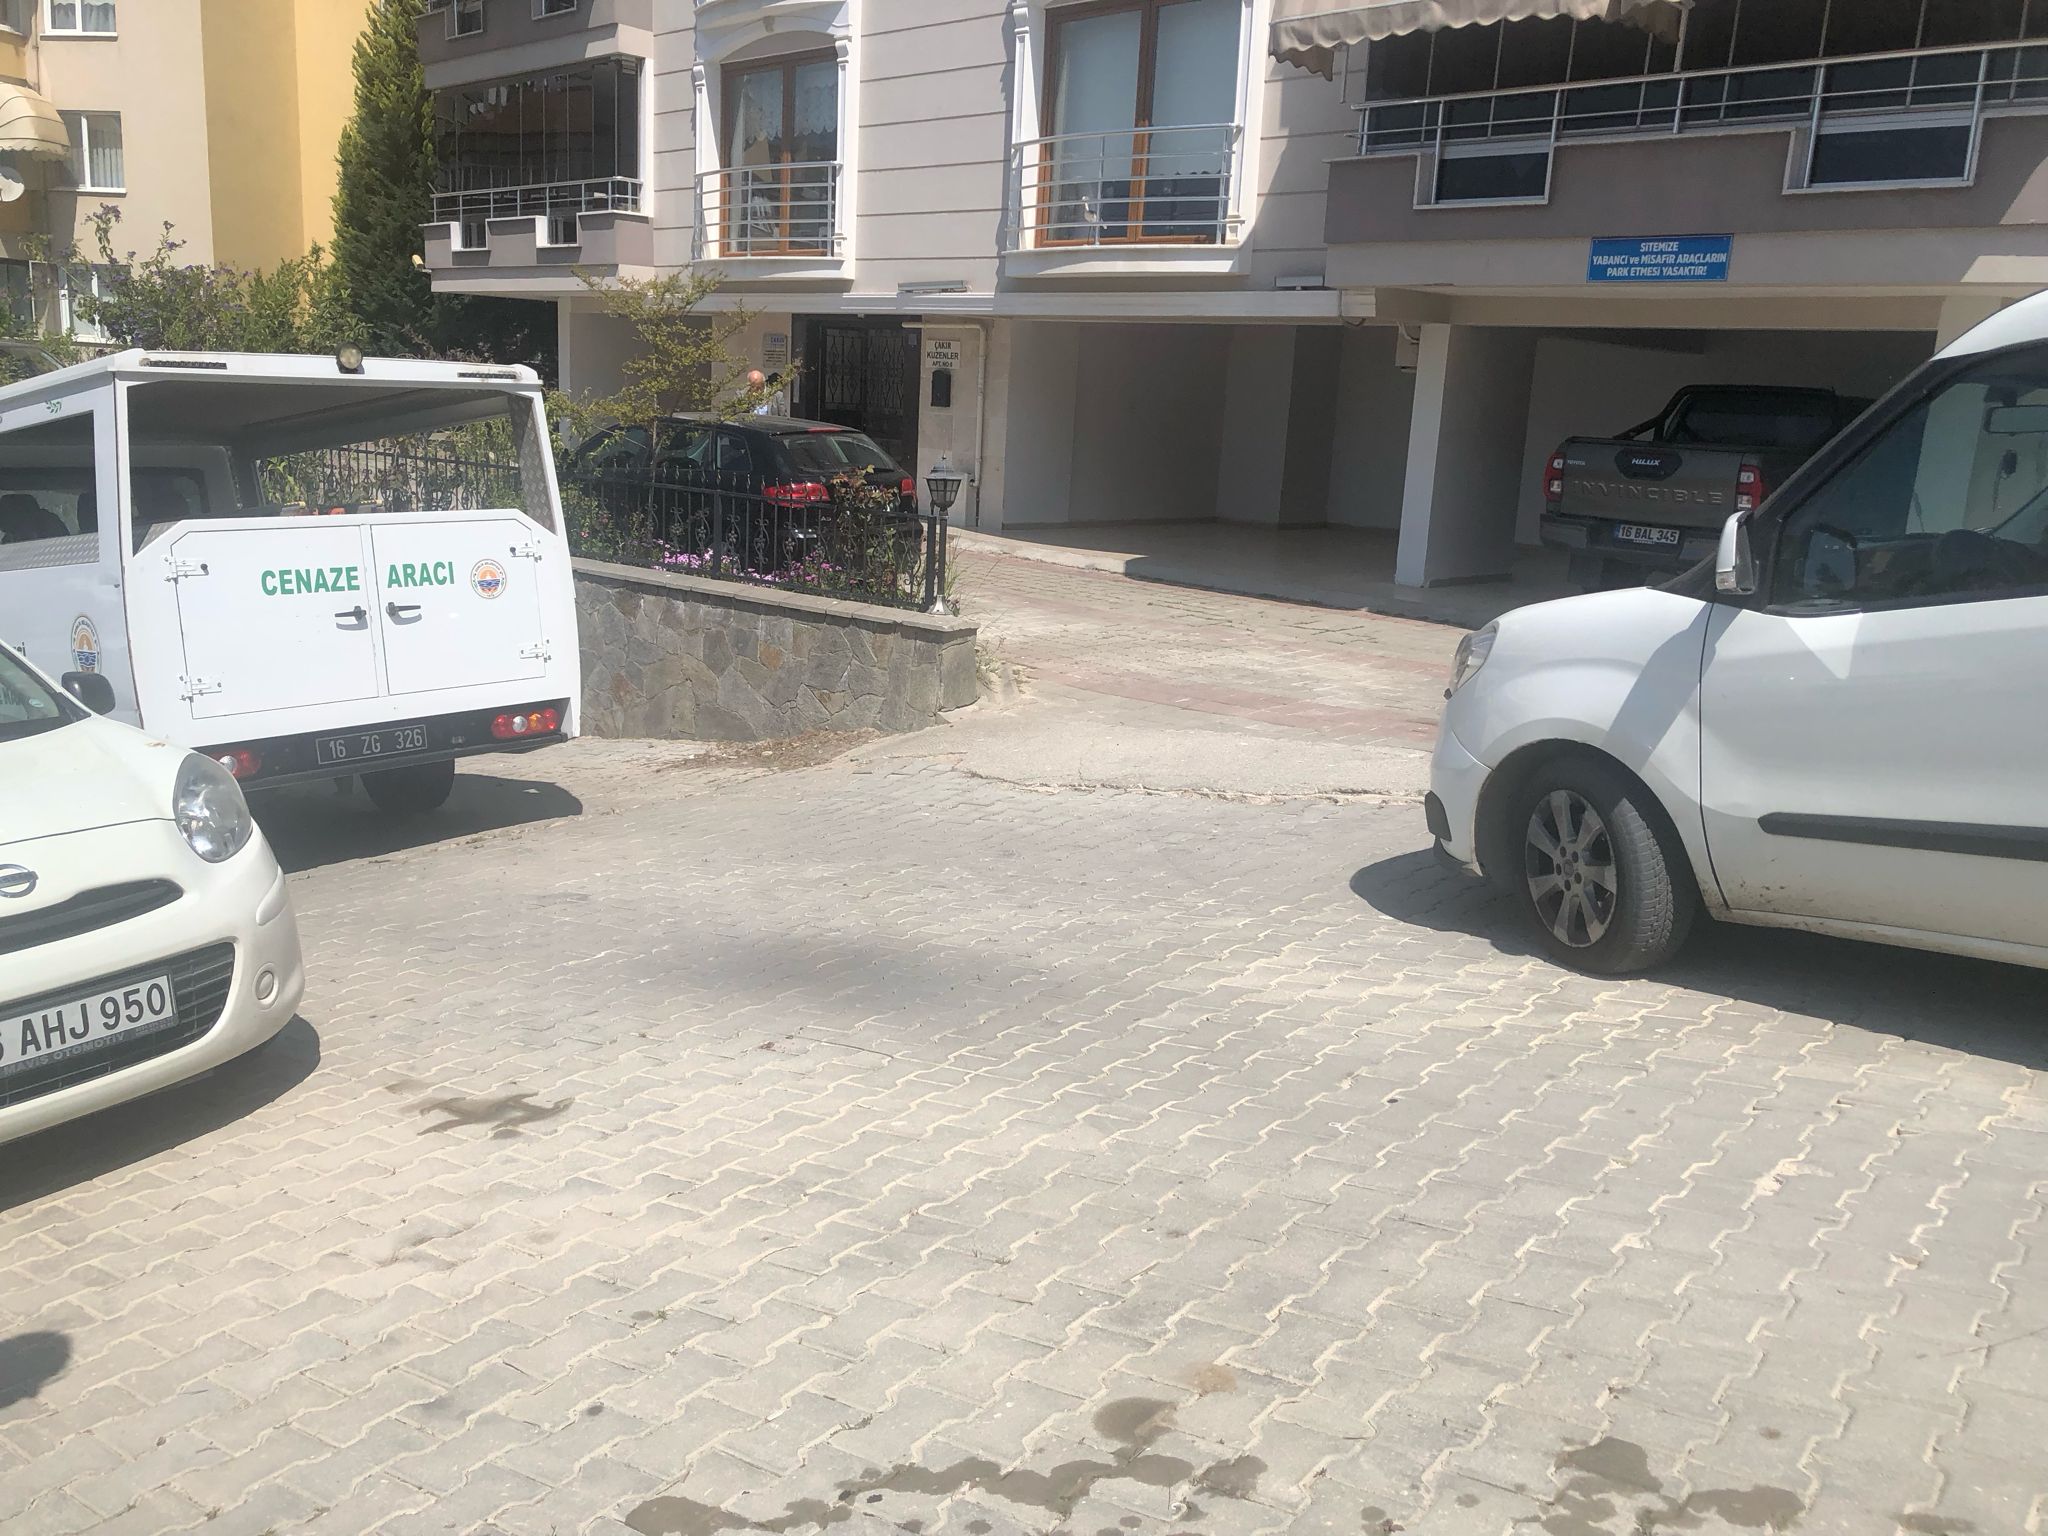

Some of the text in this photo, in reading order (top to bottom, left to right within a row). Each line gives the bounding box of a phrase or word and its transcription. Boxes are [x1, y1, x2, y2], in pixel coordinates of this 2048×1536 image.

[1640, 241, 1679, 252] SİTEMİZE
[1592, 252, 1727, 265] YABANCI ve MİSAFİR ARAÇLARIN
[1606, 267, 1629, 277] PARK
[1662, 265, 1707, 276] YASAKTIR!
[1631, 458, 1661, 466] HILUX
[1573, 480, 1722, 504] INVINCIBLE
[1621, 526, 1633, 537] 16
[1634, 527, 1654, 539] BAL
[1656, 530, 1678, 542] 345
[261, 566, 360, 596] CENAZE
[387, 561, 455, 588] ARACI
[329, 728, 423, 759] 16 ZG 326
[21, 1003, 90, 1056] AHJ
[100, 983, 166, 1031] 950
